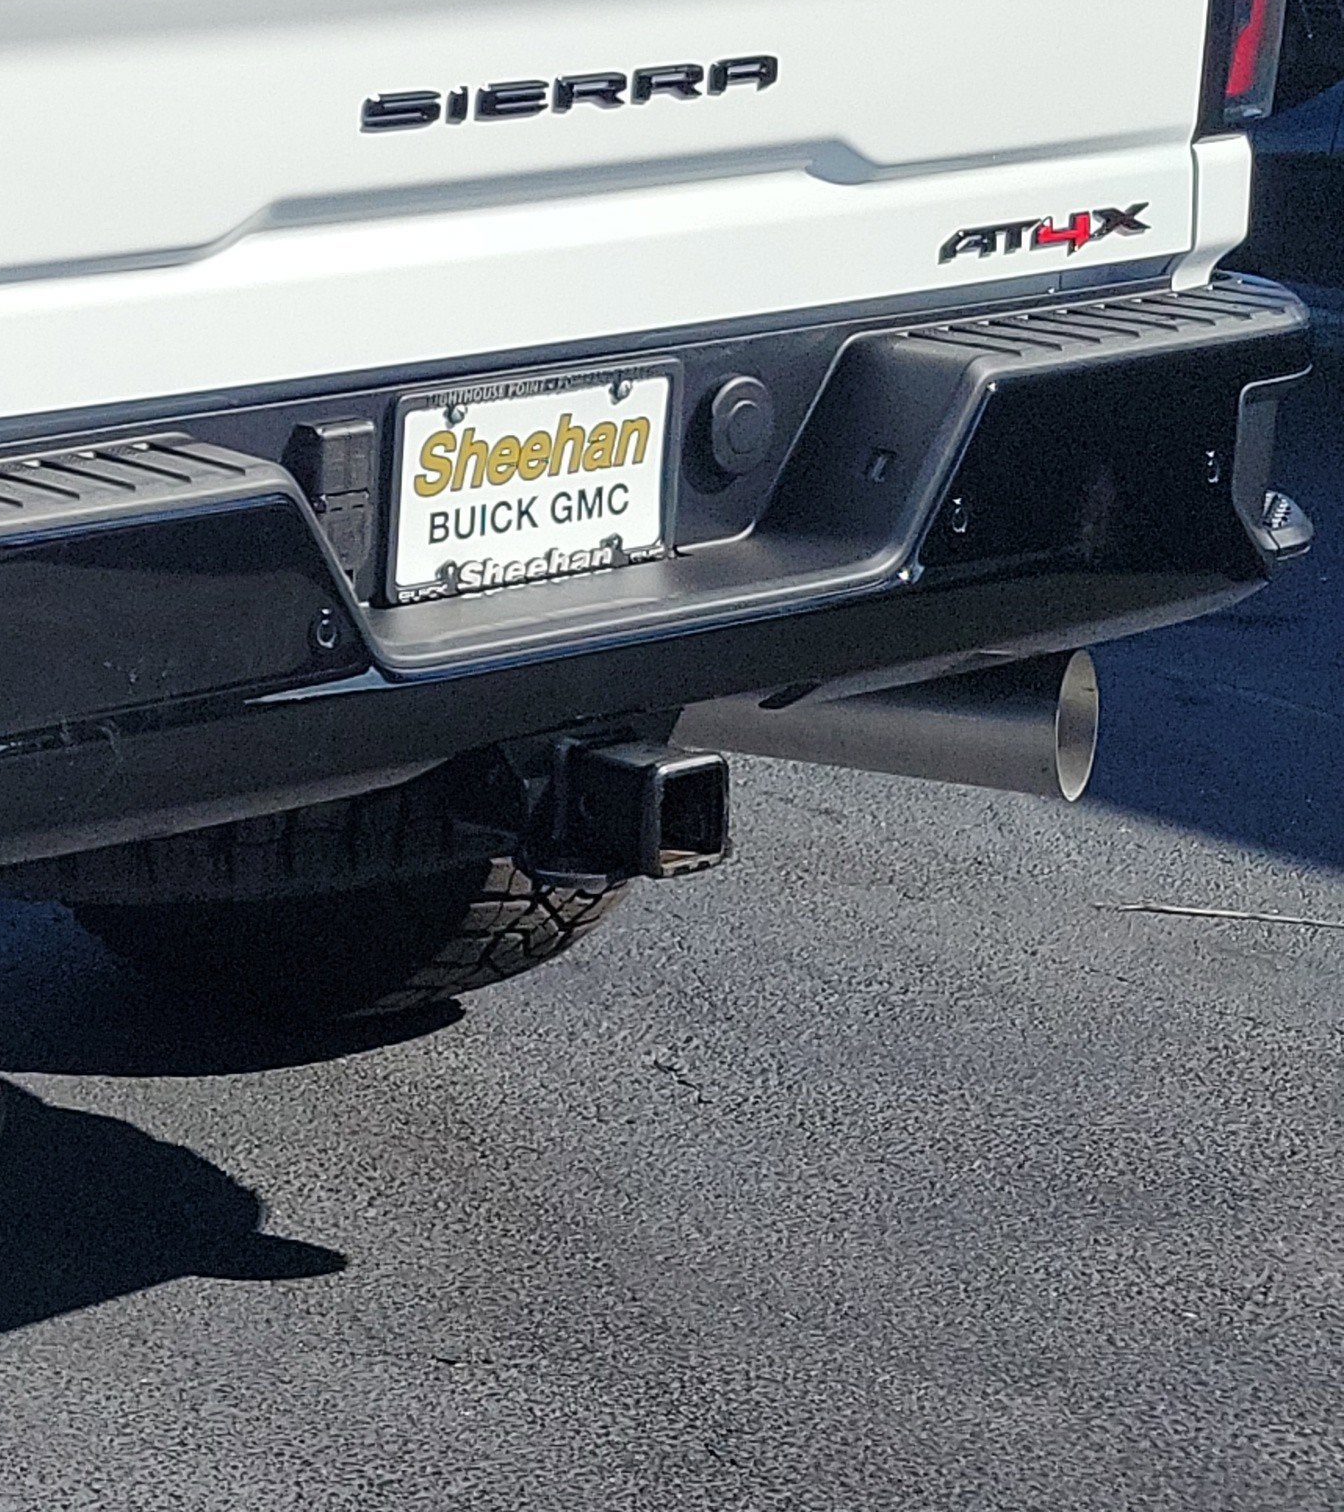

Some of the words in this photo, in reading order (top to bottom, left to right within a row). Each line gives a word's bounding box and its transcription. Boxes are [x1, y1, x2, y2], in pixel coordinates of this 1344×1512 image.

[360, 55, 779, 133] SIERRA
[938, 201, 1151, 266] AT4X
[413, 413, 651, 498] Sheehan
[428, 495, 539, 545] BUICK
[550, 483, 630, 525] GMC
